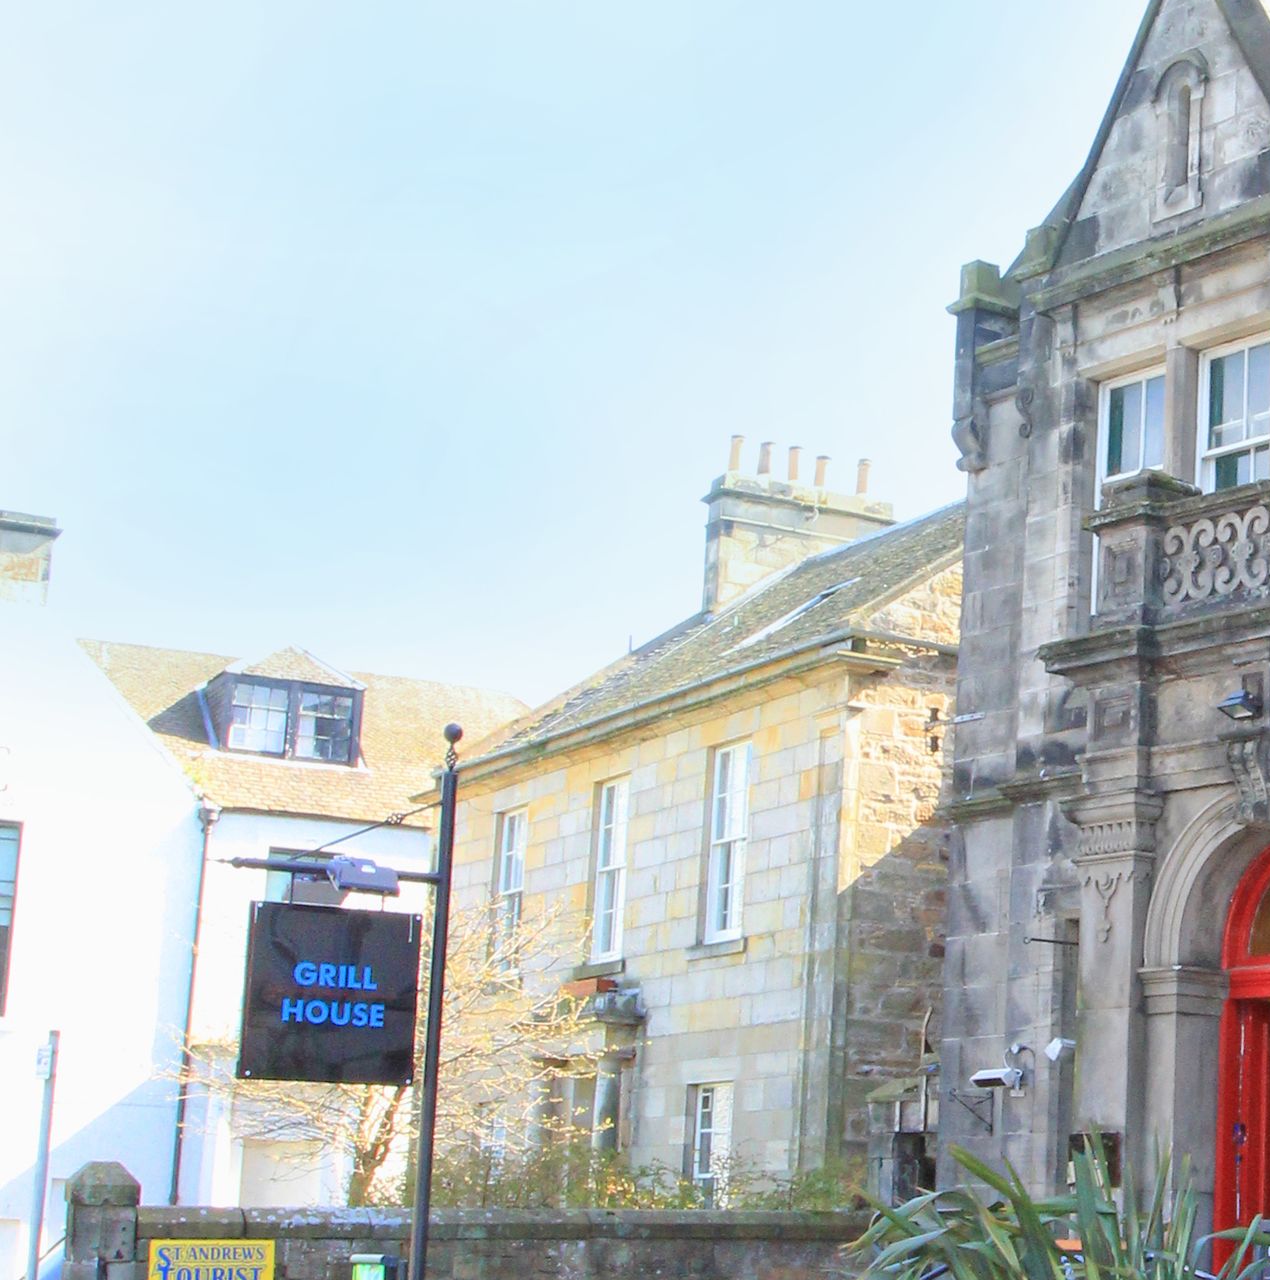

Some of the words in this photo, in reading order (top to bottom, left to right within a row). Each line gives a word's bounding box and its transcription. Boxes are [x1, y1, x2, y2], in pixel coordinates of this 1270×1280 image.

[293, 960, 378, 991] GRILL
[281, 997, 385, 1028] HOUSE
[188, 1247, 264, 1261] ANDREWS
